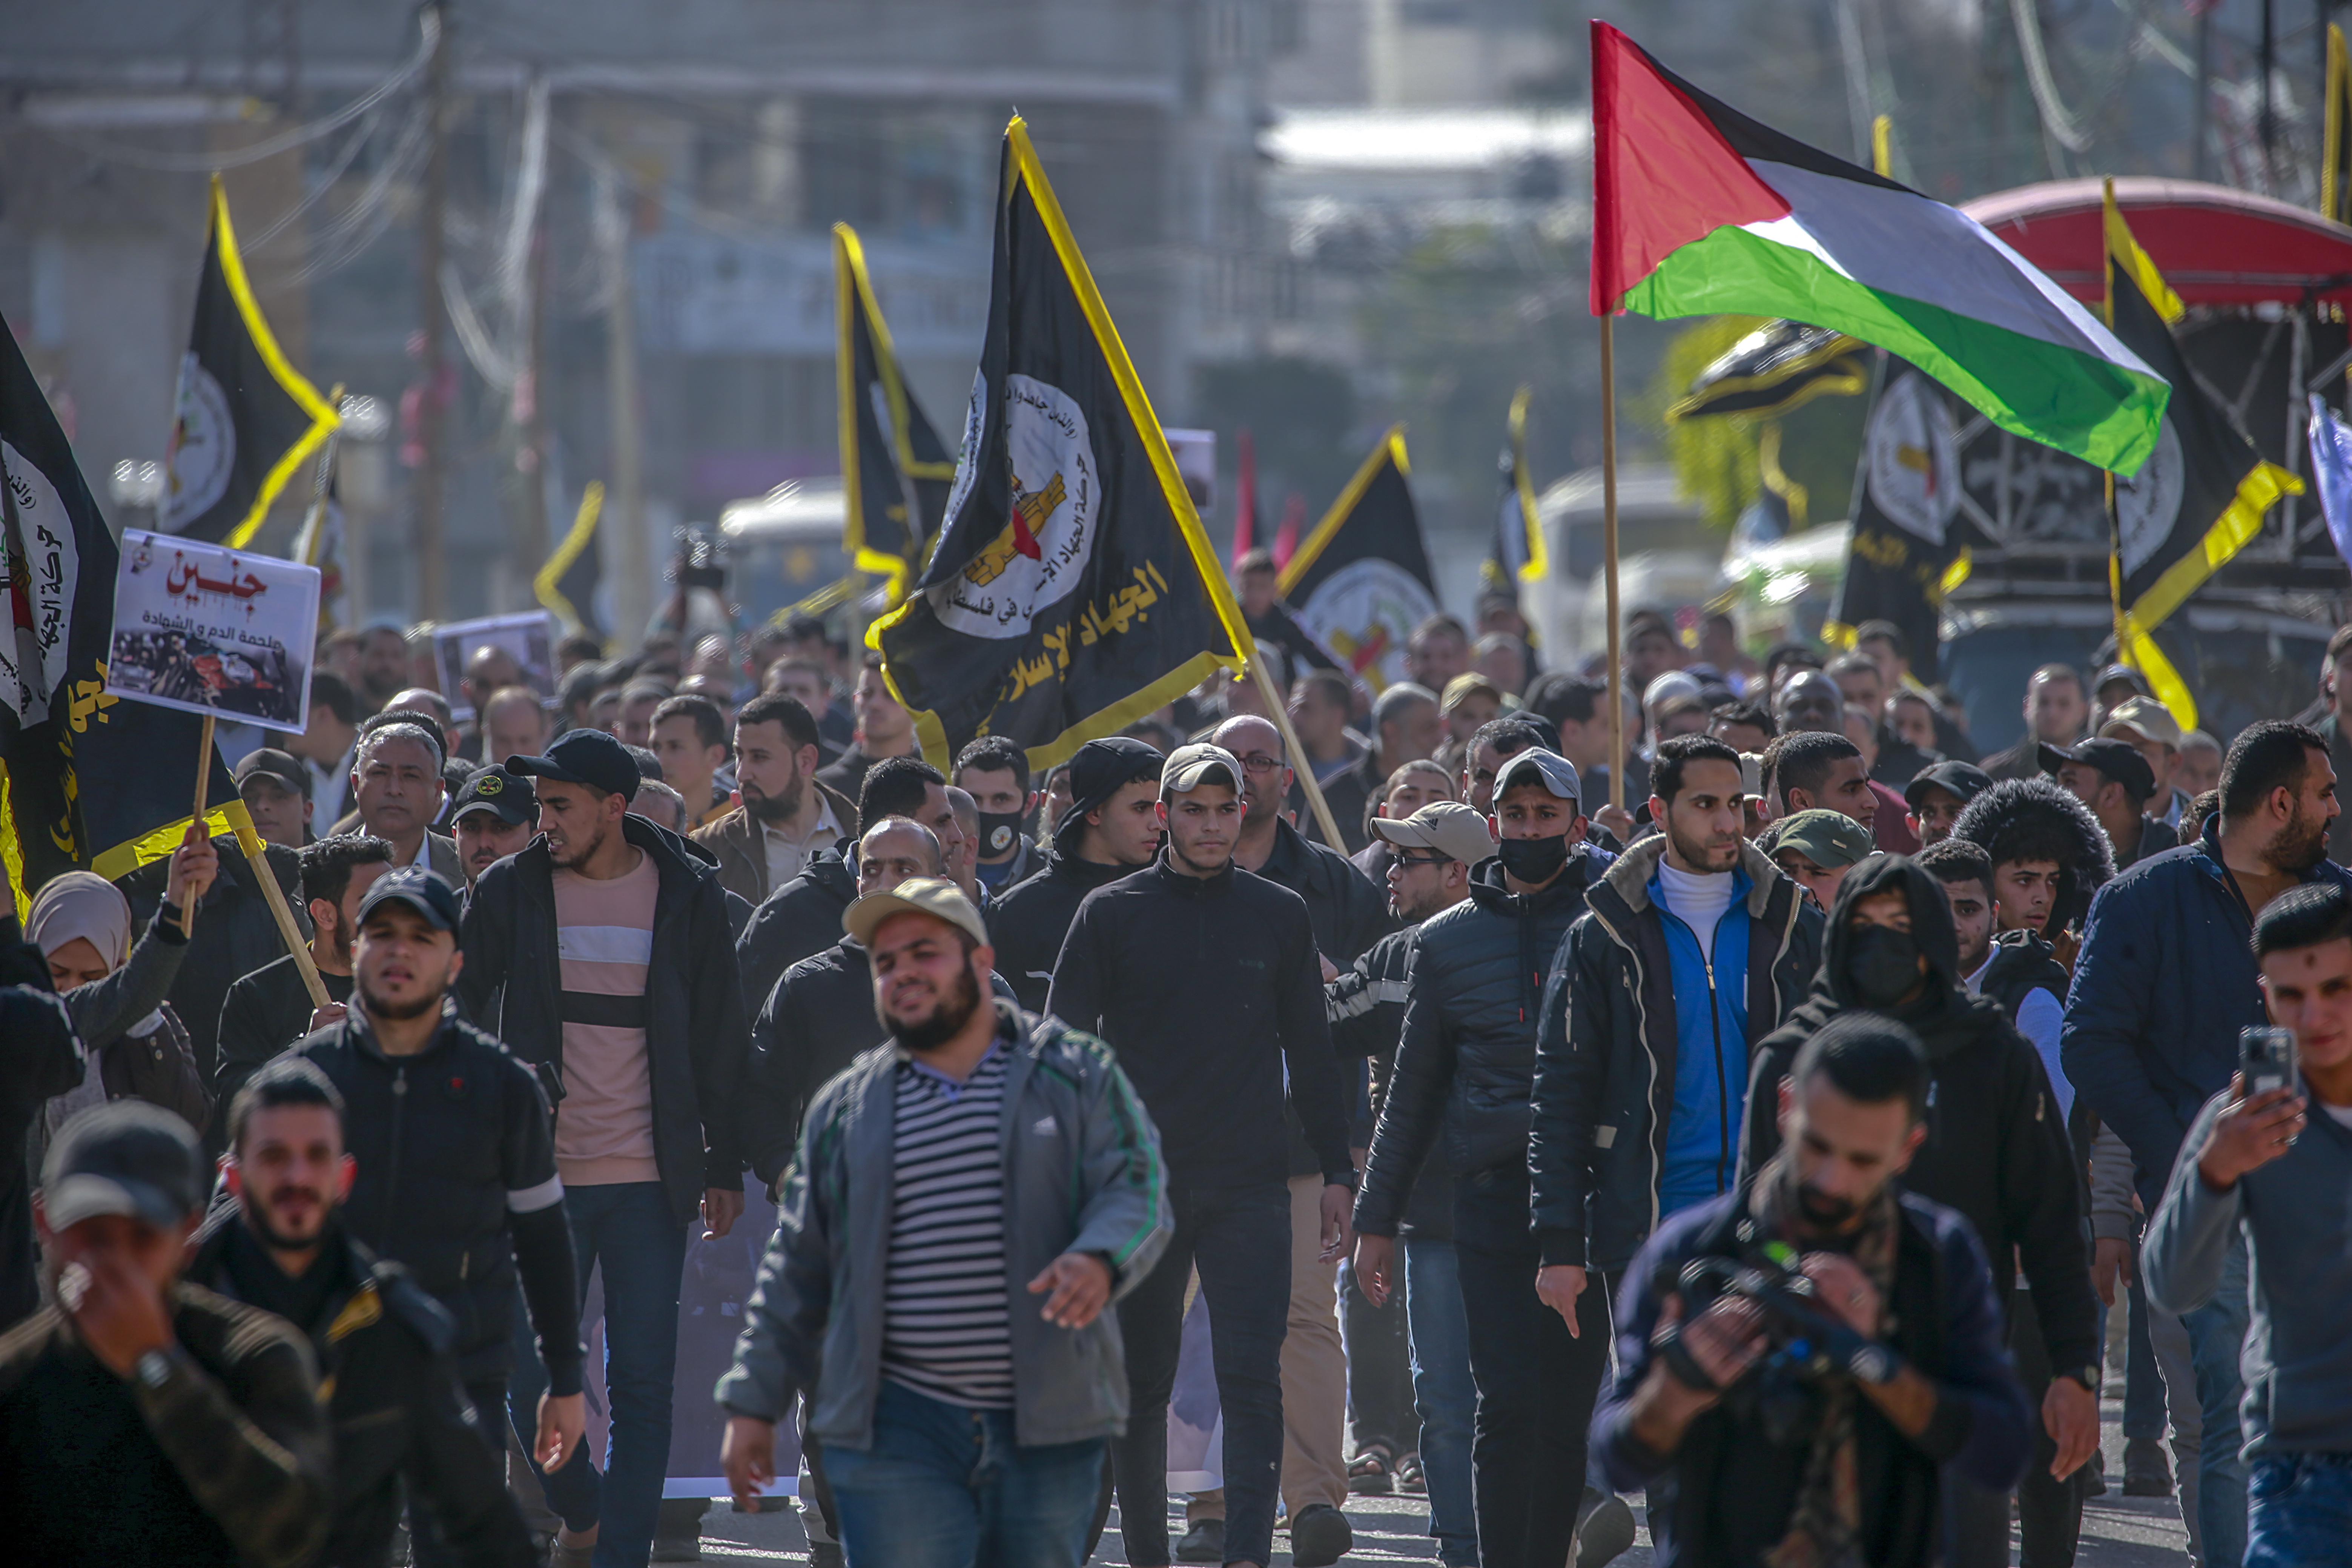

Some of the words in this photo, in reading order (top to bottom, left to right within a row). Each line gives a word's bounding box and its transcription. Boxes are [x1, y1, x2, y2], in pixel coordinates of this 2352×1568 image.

[1075, 453, 1090, 514] حركة
[1059, 514, 1085, 565] الجهاد
[37, 525, 63, 595] حركة
[166, 549, 267, 613] جنين
[947, 588, 994, 616] فلسط
[998, 597, 1017, 626] في
[1080, 559, 1168, 647] الجهاد
[142, 610, 193, 629] الشهادة
[197, 624, 205, 635] و
[207, 625, 235, 640] الدم
[239, 630, 281, 648] ملحمة
